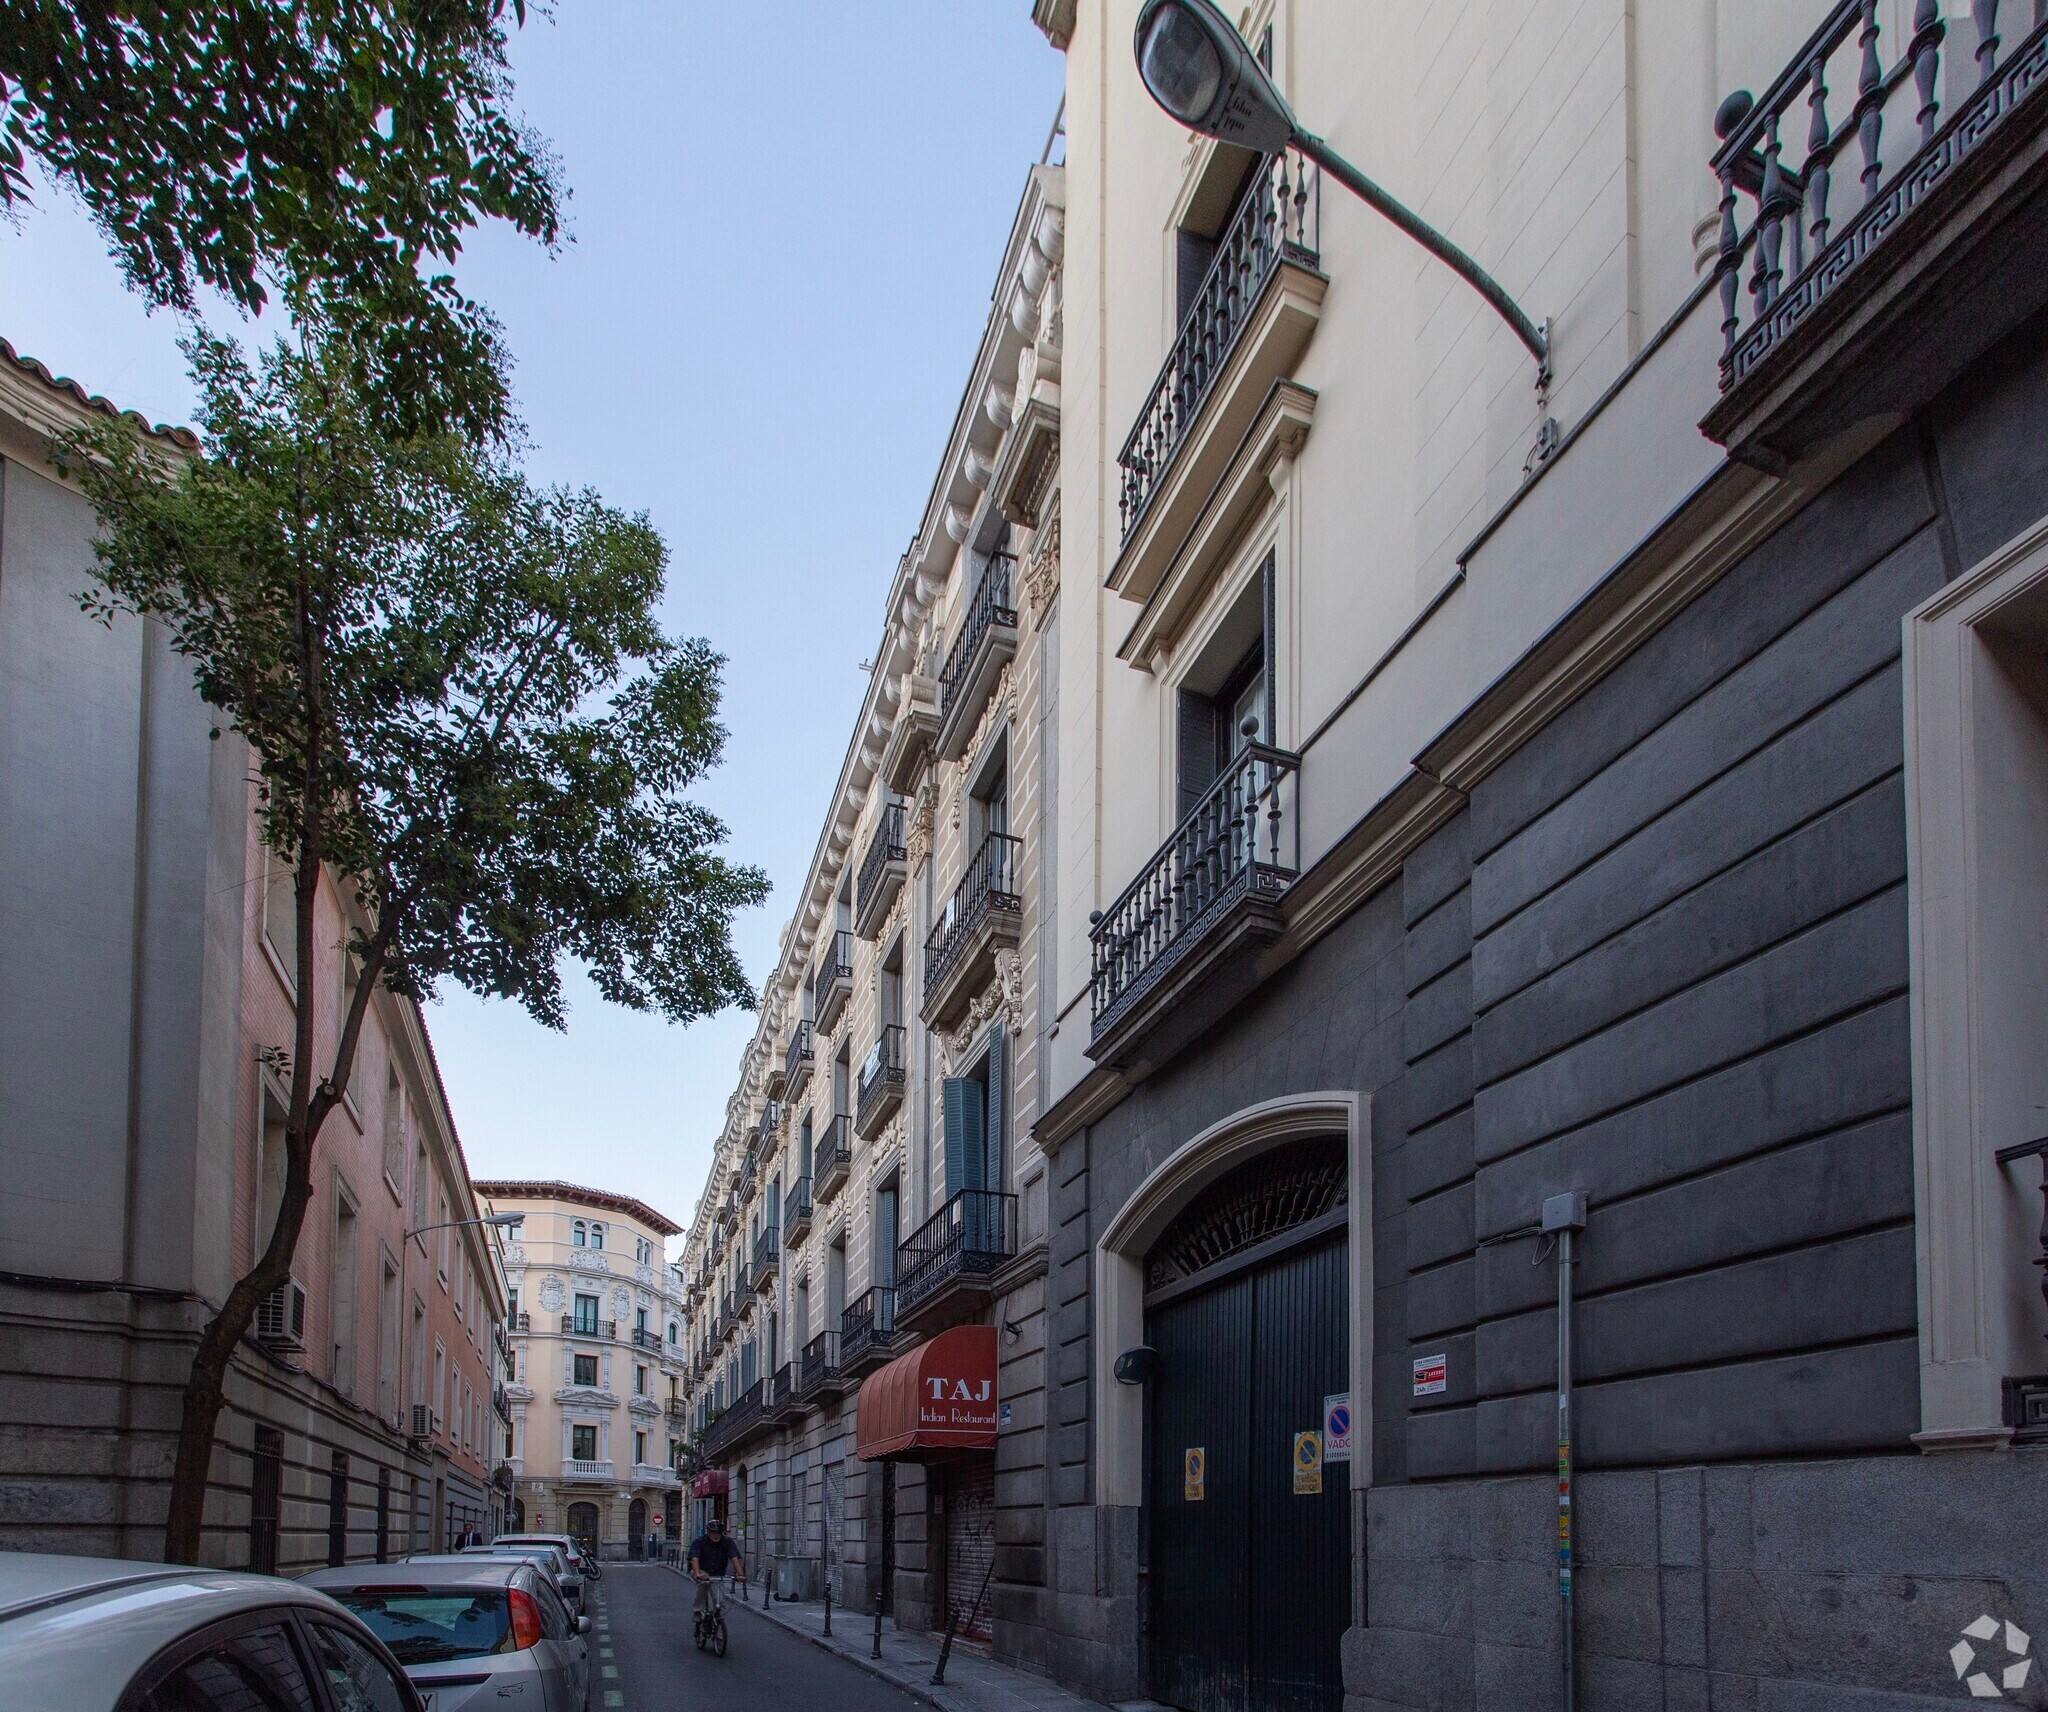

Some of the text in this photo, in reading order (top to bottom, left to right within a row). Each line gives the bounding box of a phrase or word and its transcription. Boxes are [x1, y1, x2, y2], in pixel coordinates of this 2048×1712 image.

[926, 1378, 991, 1401] TAJ
[922, 1407, 946, 1422] Indian
[952, 1408, 995, 1423] Restaurant
